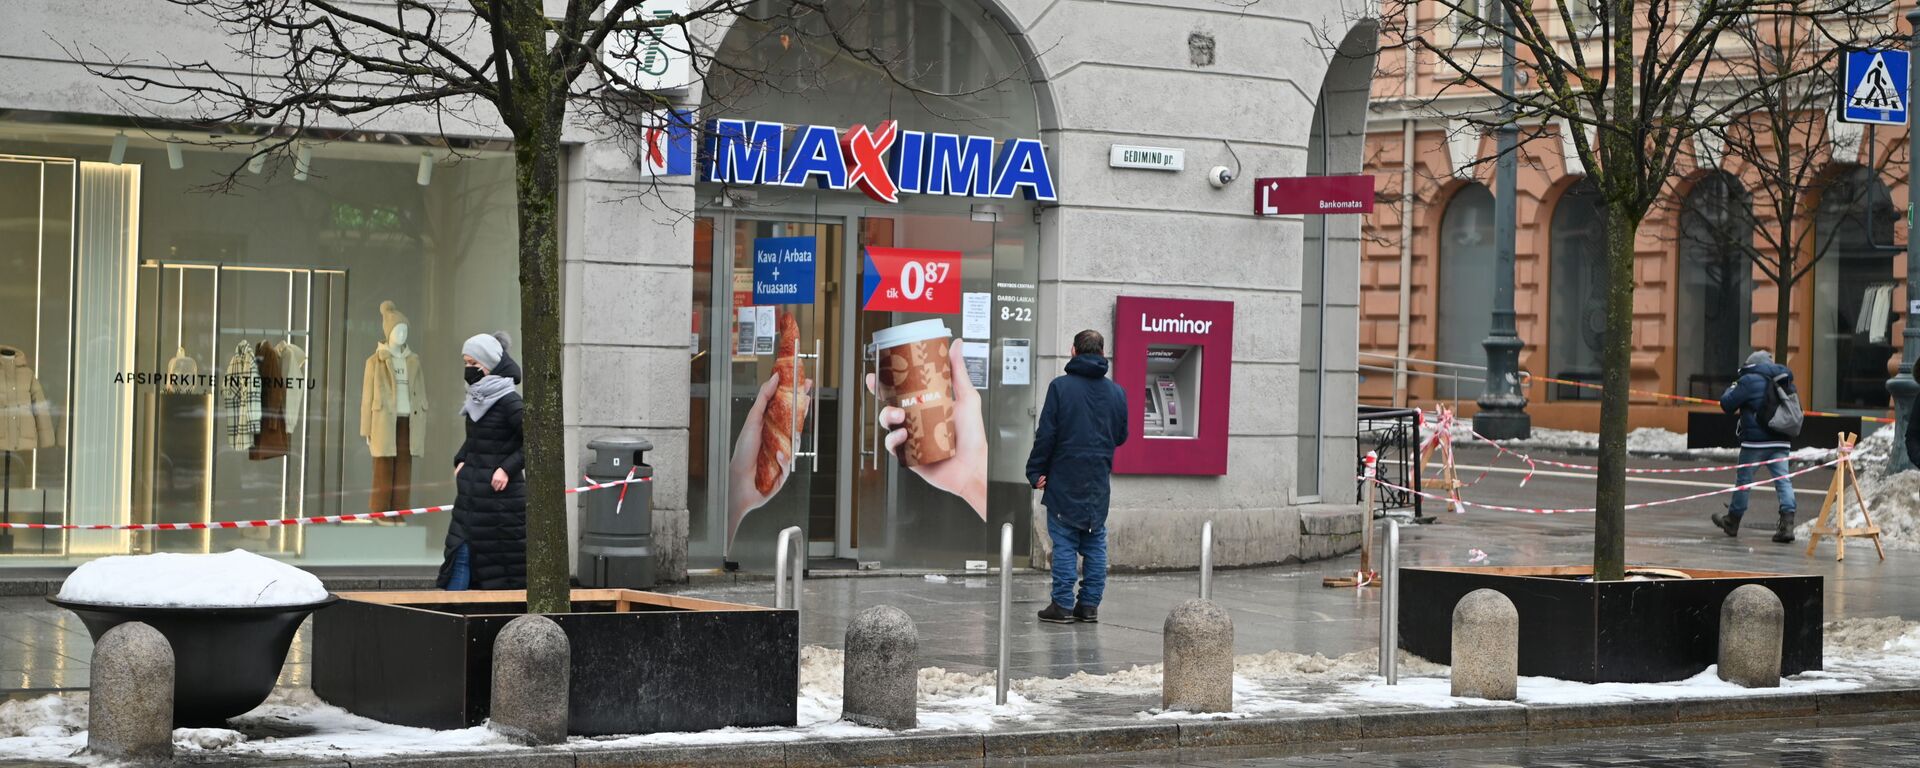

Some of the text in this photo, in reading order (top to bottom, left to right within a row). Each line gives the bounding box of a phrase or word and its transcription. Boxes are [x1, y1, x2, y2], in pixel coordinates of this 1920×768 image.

[704, 119, 1058, 204] MAXIMA
[1123, 149, 1174, 166] GEDIMINO pr.
[1319, 200, 1363, 209] Bankomatas
[757, 249, 777, 263] Kava
[783, 247, 812, 262] Arbata
[756, 280, 798, 294] Kruasanas
[886, 287, 899, 299] tik
[997, 294, 1015, 302] DARBO
[1001, 306, 1032, 321] 8-22
[1141, 312, 1213, 334] Luminor
[114, 372, 316, 390] APSIPIRKITE INTERNETU
[901, 391, 941, 408] MAXIMA
